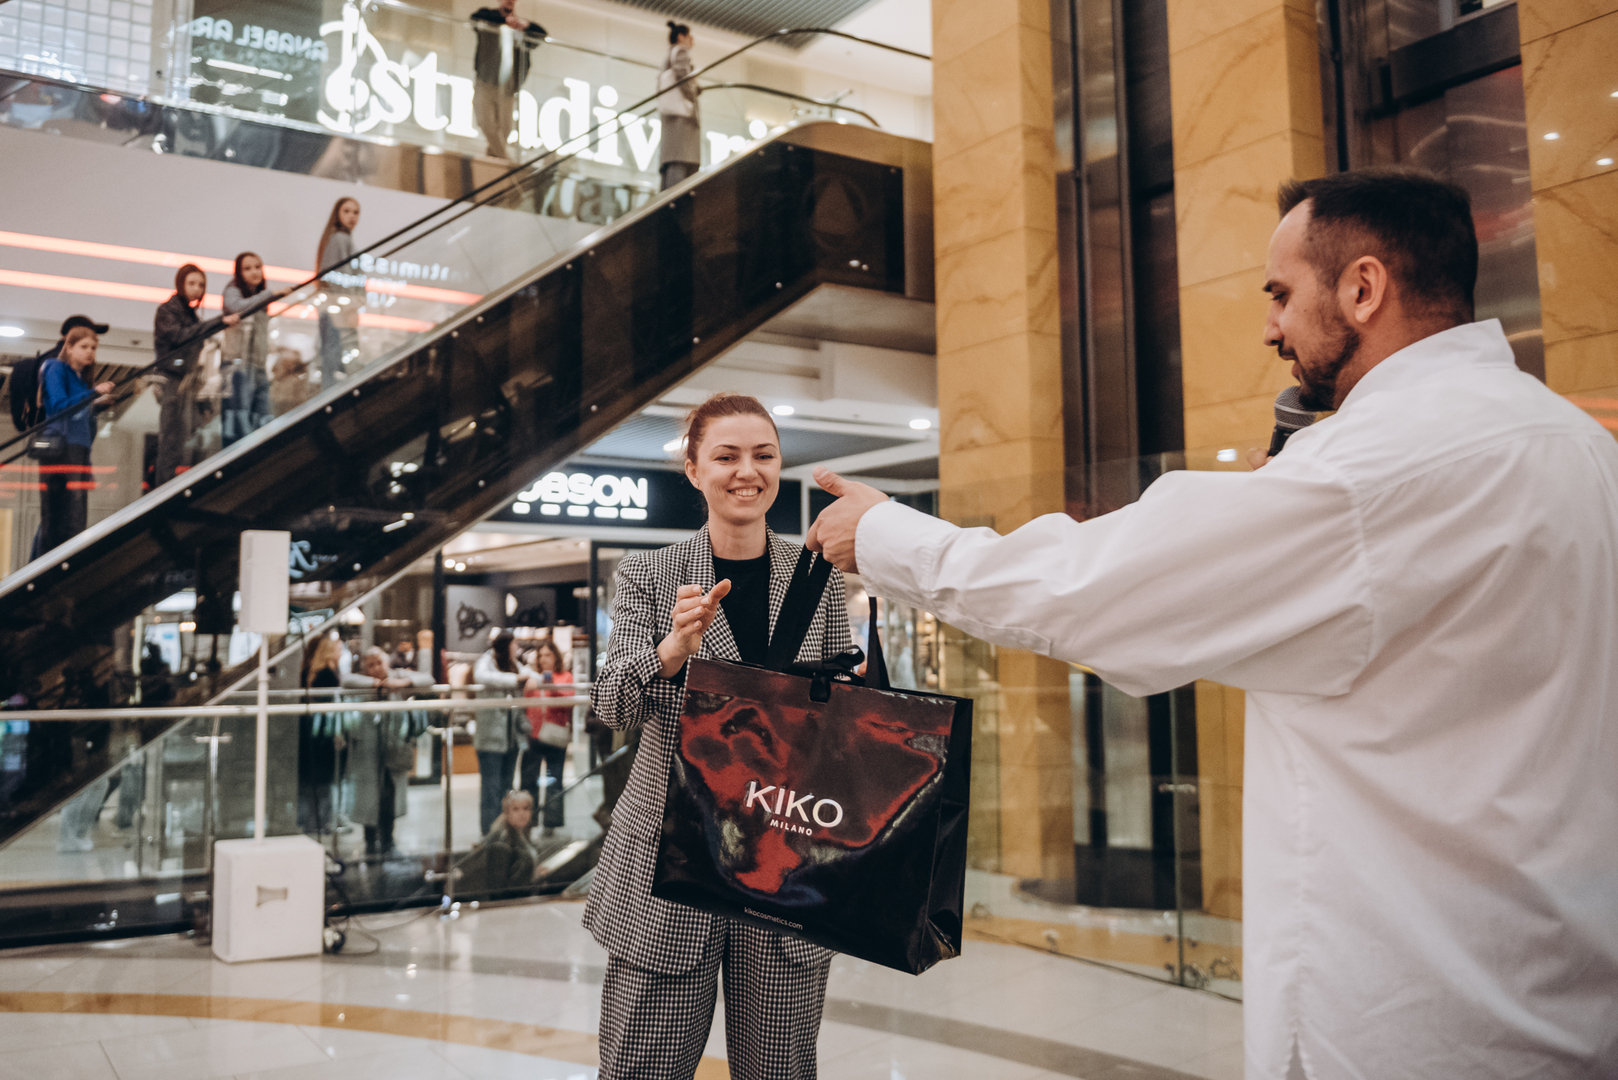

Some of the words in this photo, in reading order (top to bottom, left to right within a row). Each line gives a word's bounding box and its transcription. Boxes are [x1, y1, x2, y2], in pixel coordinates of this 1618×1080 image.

[746, 781, 843, 828] KIKO
[770, 819, 813, 836] MILANO
[744, 906, 803, 930] kikocosmetics.com
